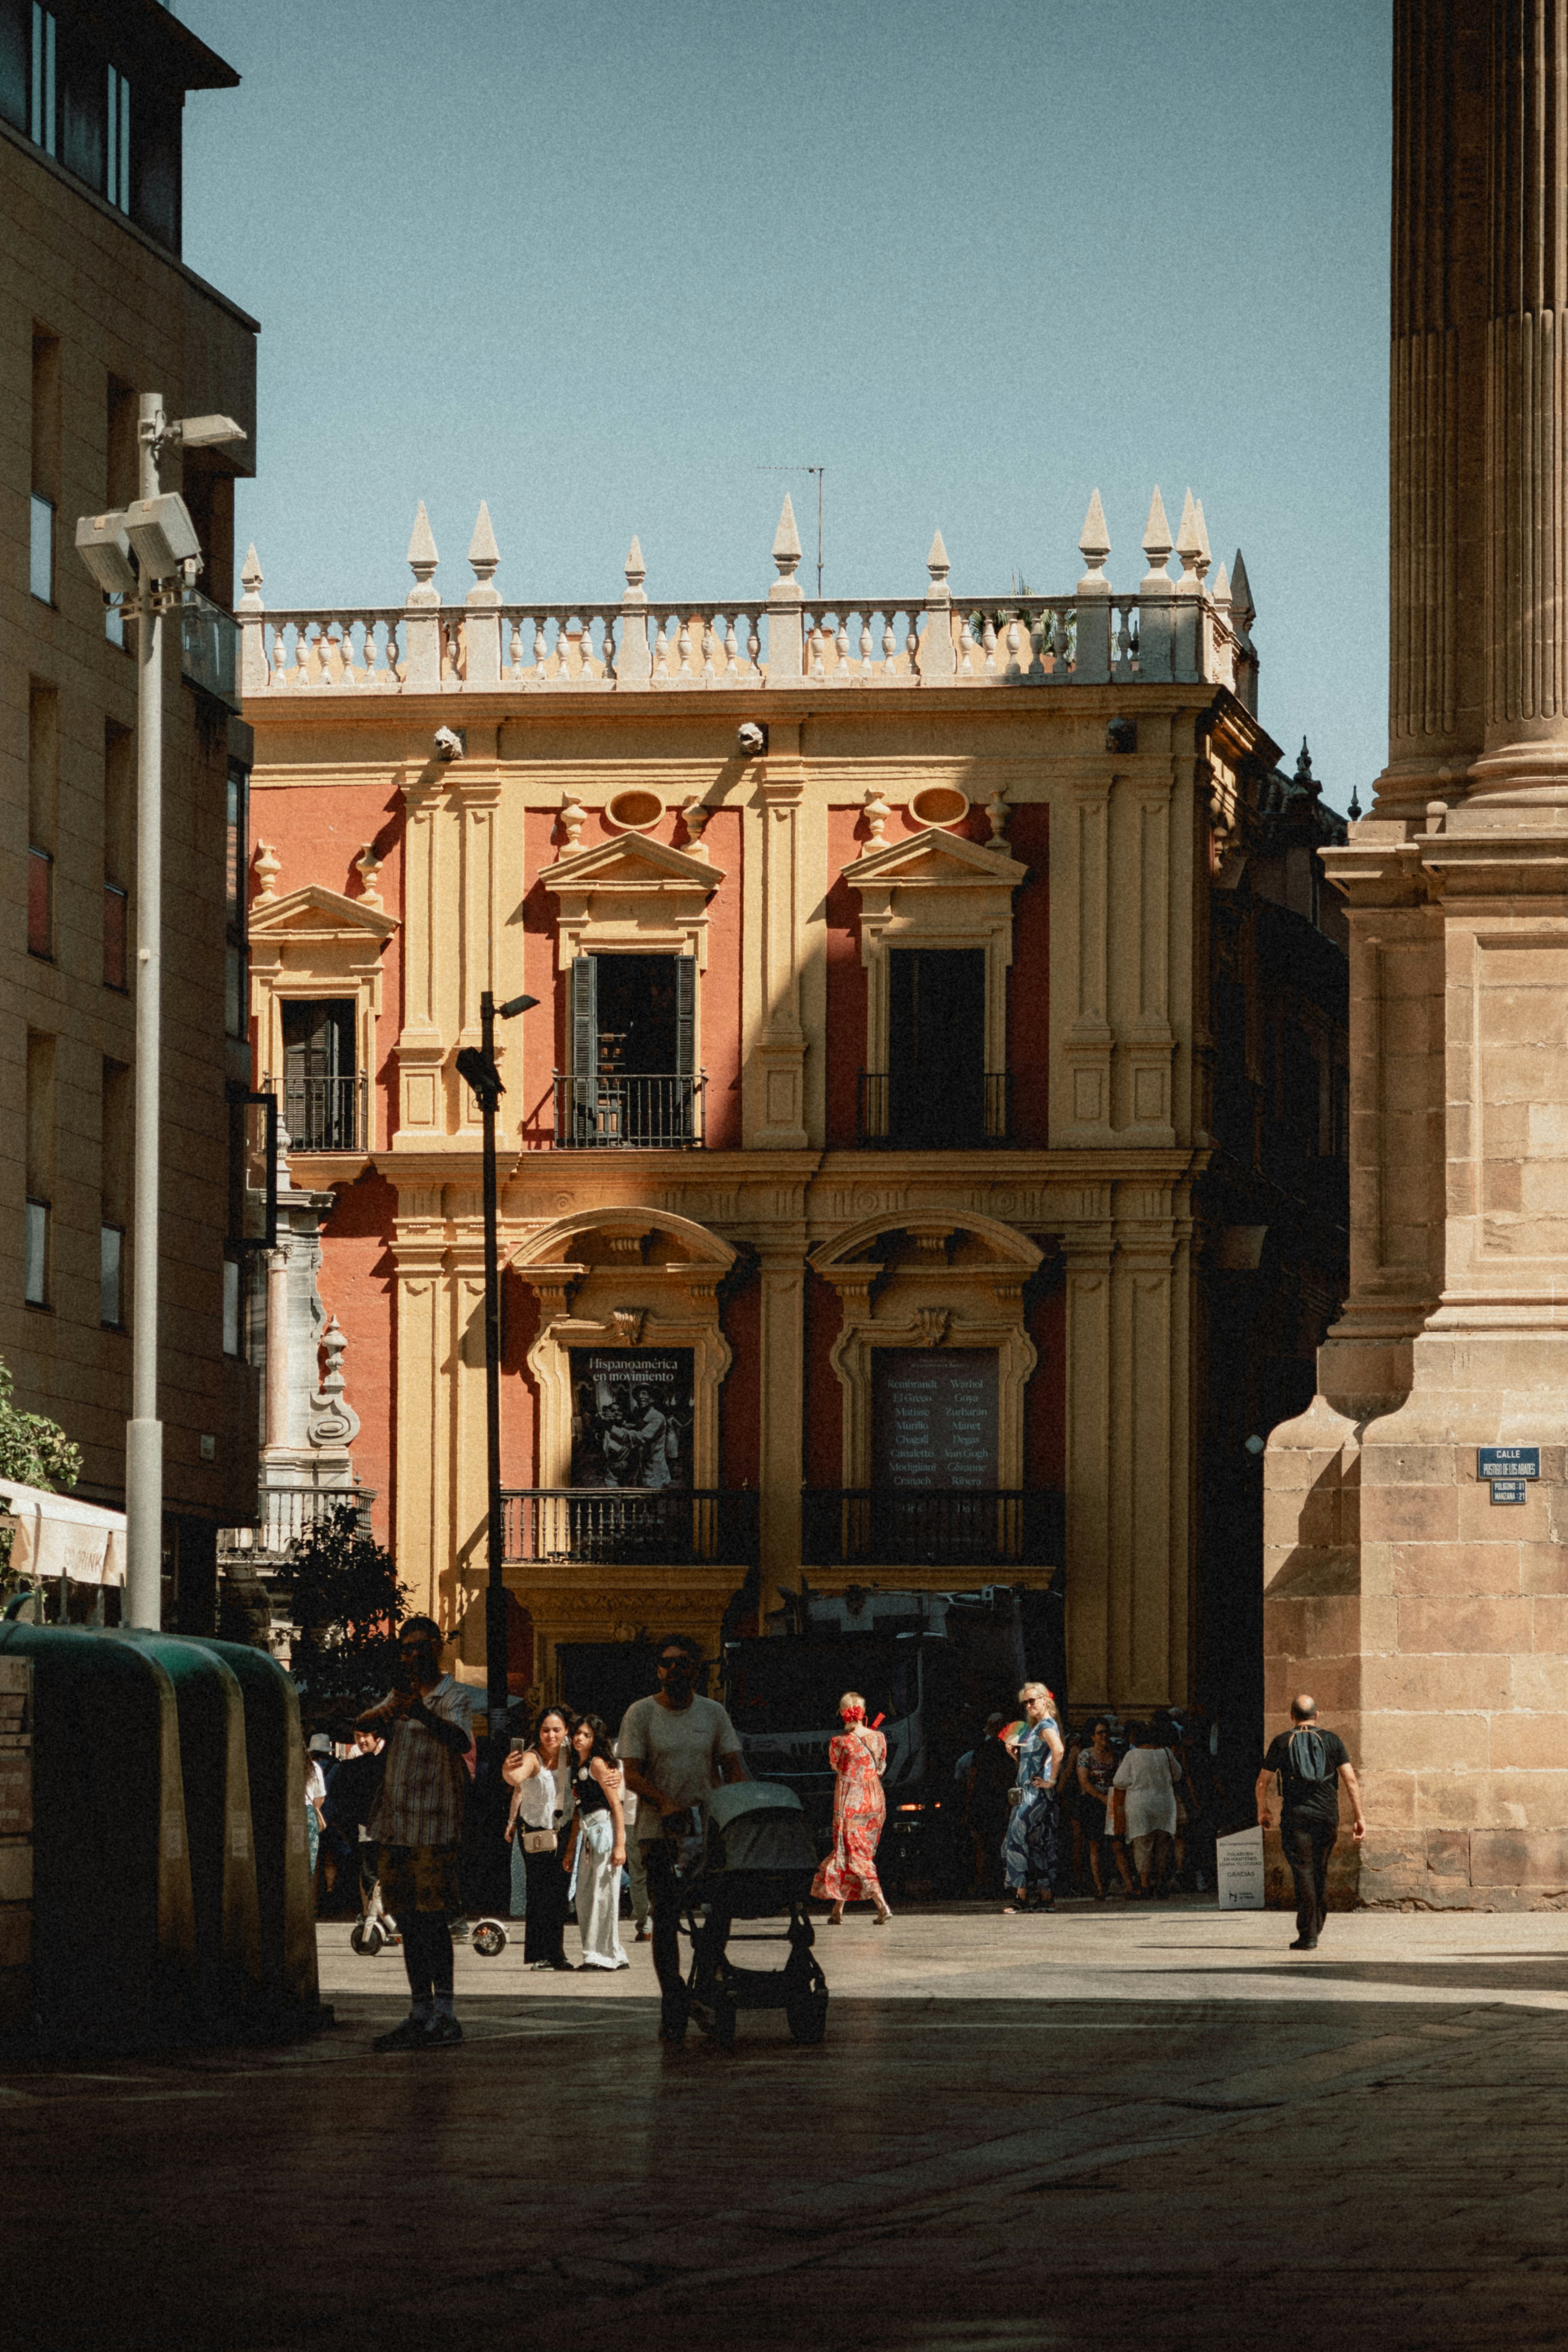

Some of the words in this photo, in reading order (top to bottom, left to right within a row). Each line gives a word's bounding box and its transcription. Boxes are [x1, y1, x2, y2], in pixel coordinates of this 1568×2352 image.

[589, 1358, 678, 1371] Hispanoamérica
[609, 1371, 674, 1381] movimiento
[888, 1379, 938, 1388] Rembrandt
[950, 1379, 983, 1388] Warhol
[893, 1394, 902, 1402] El
[905, 1393, 932, 1402] Greco
[954, 1394, 978, 1404] Goya
[895, 1408, 929, 1416] Matisse
[946, 1407, 987, 1416] Zurbarán
[896, 1421, 929, 1430] Murillo
[952, 1421, 980, 1430] Manet
[895, 1435, 928, 1446] Chagall
[953, 1436, 980, 1446] Degas
[890, 1449, 934, 1458] Canaletto
[964, 1449, 988, 1460] Gogh
[1496, 1450, 1520, 1458] CALLE
[889, 1463, 936, 1474] Modigliani
[947, 1463, 986, 1472] Cézanne
[1483, 1463, 1502, 1475] POSTIGO
[1503, 1463, 1509, 1475] DE
[1518, 1463, 1535, 1475] ABADES
[894, 1476, 931, 1486] Cranach
[952, 1476, 981, 1486] Ribera
